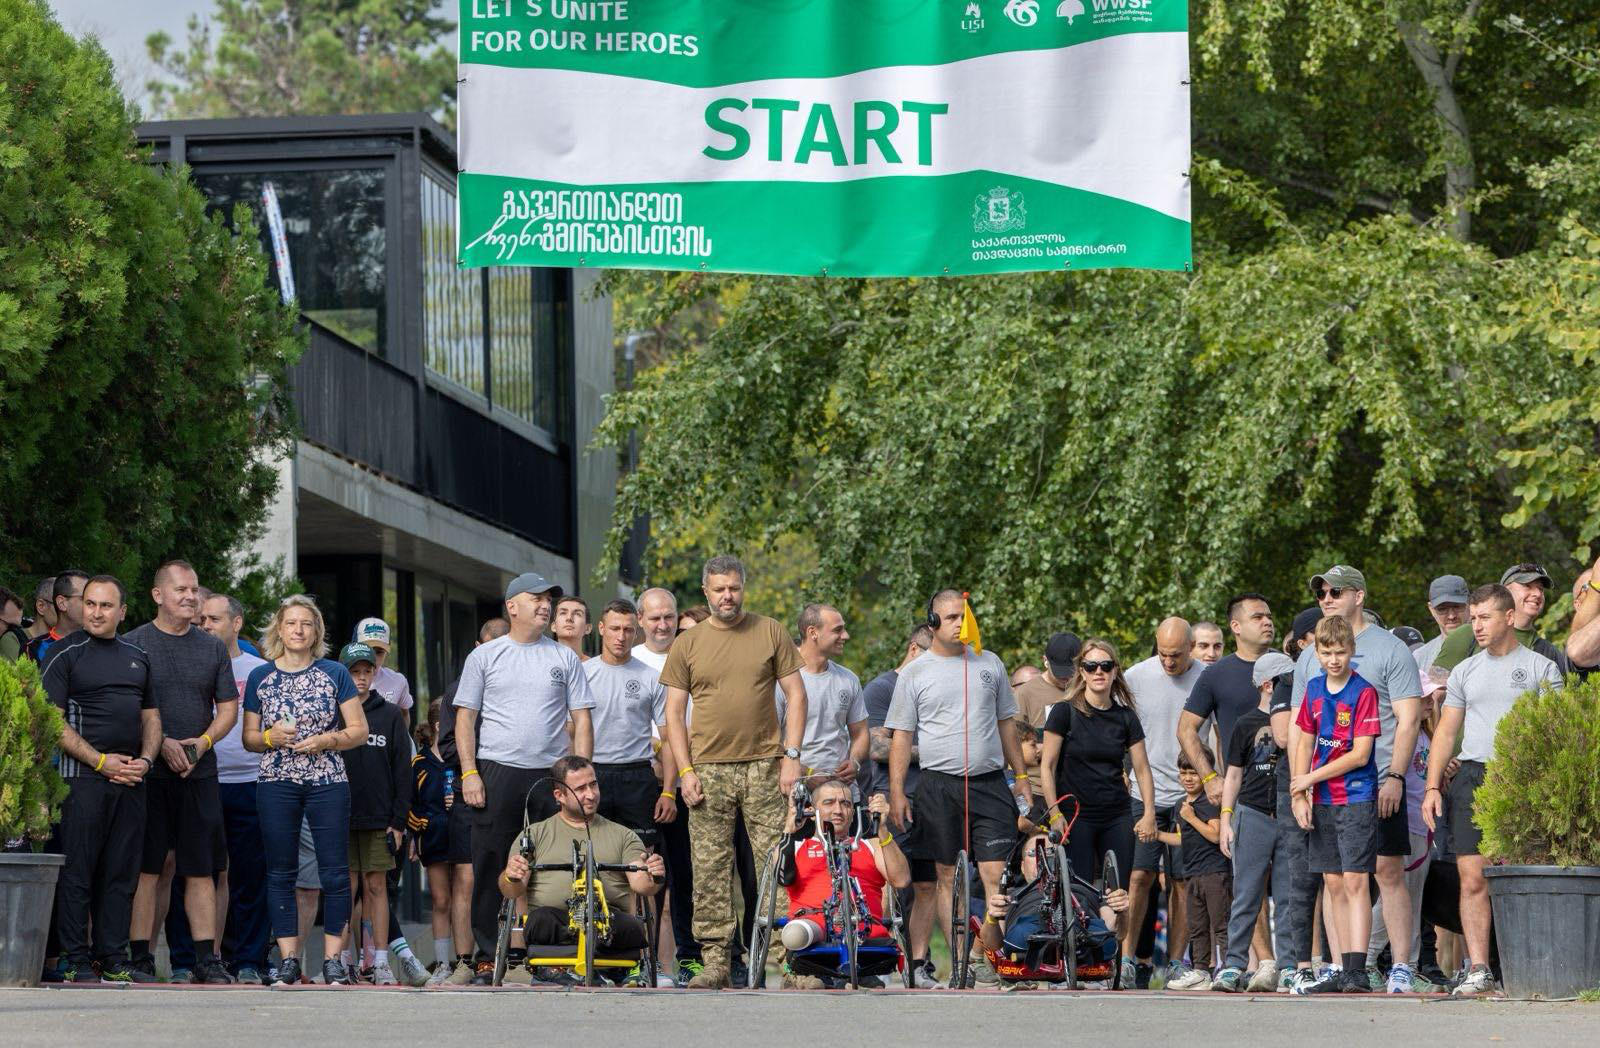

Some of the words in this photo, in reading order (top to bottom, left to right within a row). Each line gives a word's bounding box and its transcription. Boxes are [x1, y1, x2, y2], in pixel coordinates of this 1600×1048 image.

[551, 0, 629, 21] UNITE
[1092, 0, 1152, 11] WWSF
[961, 19, 985, 29] LISI
[472, 31, 522, 51] FOR
[529, 28, 586, 50] OUR
[595, 32, 699, 57] HEROES
[702, 98, 949, 166] START
[502, 190, 683, 223] გავერთიანდეთ
[542, 222, 713, 257] გმირებისთვის
[972, 233, 1066, 249] საქართველოს
[972, 248, 1043, 261] თავდაცვის
[1046, 243, 1127, 256] სამინისტრო
[997, 964, 1026, 976] SHARK
